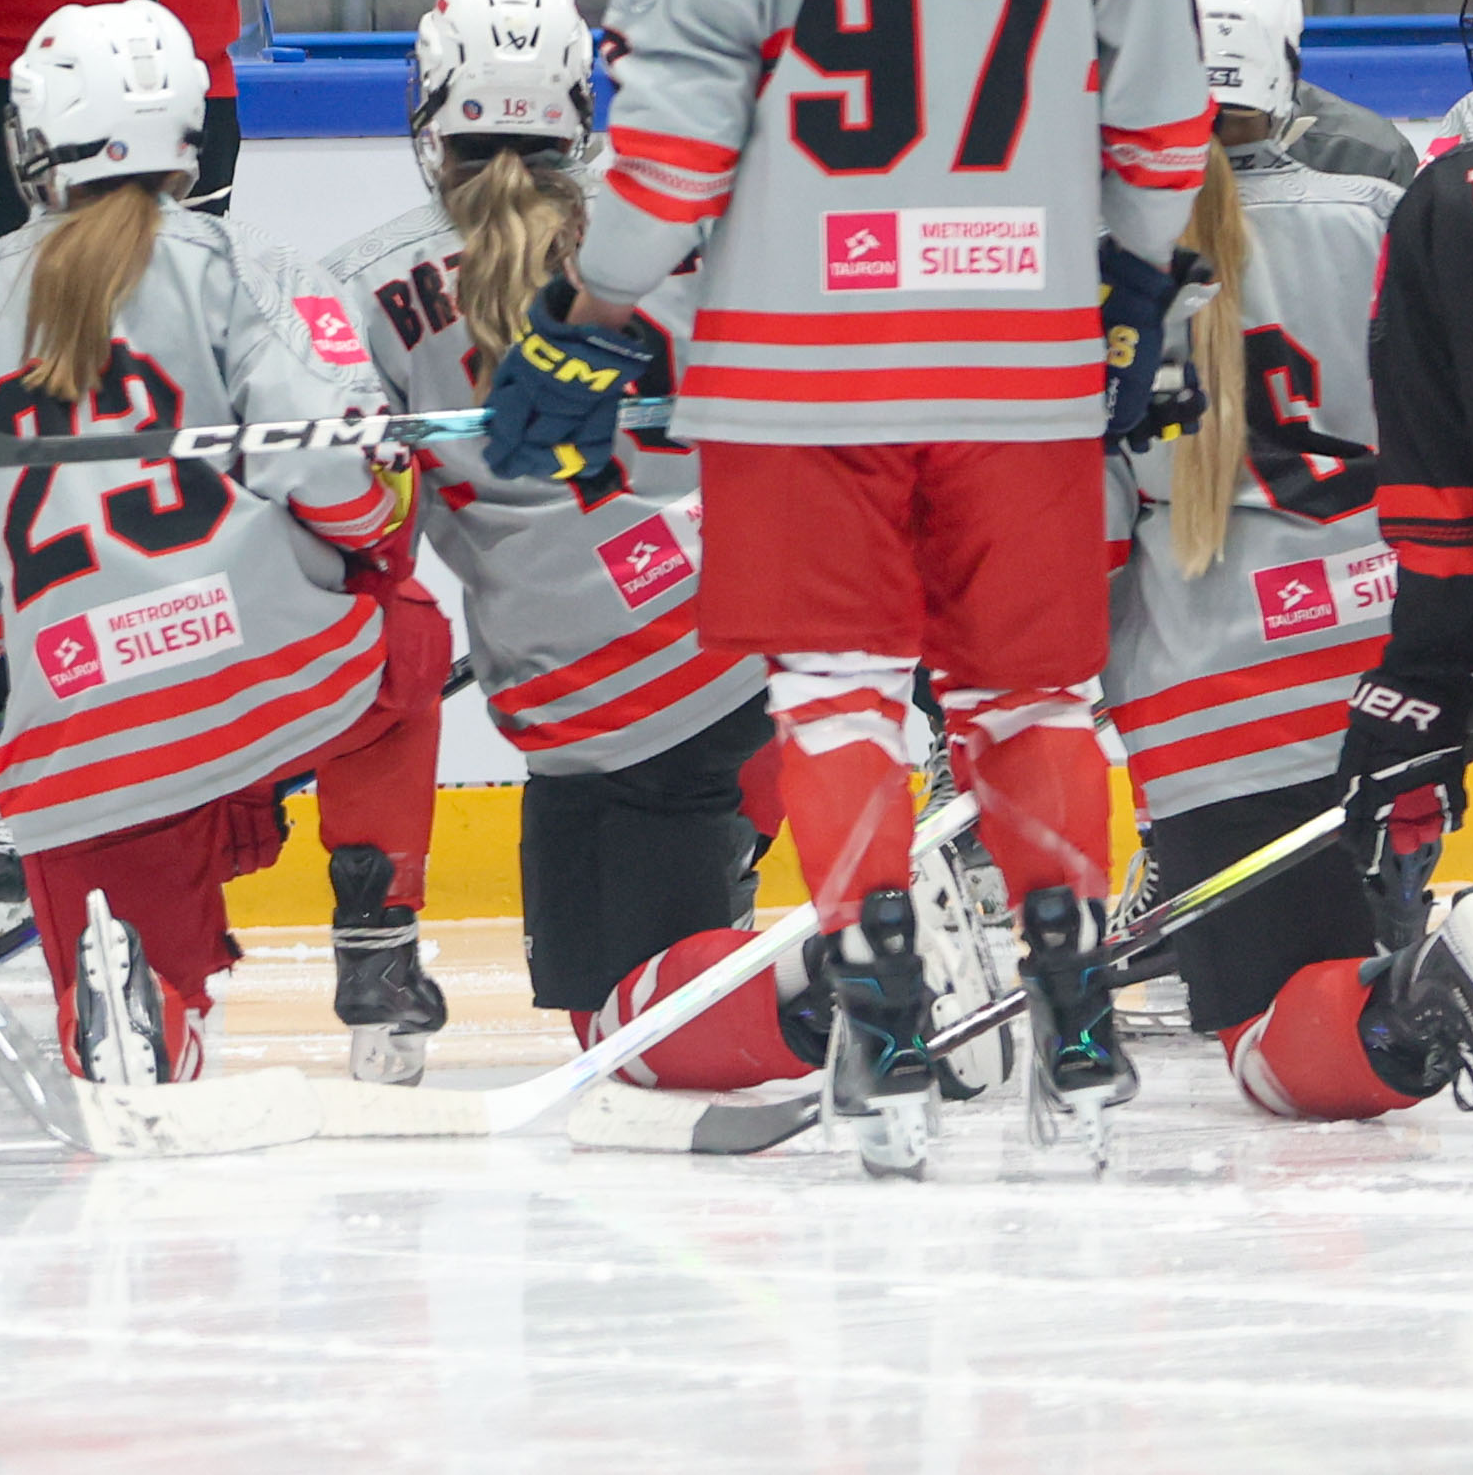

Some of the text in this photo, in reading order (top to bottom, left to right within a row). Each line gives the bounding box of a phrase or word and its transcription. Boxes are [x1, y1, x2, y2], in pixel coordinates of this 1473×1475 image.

[503, 98, 527, 118] 18
[829, 221, 1041, 278] TAURON METROPOLIA
[920, 246, 1041, 277] SILESIA
[170, 416, 390, 457] CCM
[622, 553, 685, 593] TAURON
[108, 586, 229, 634] METROPOLIA
[1264, 602, 1333, 629] TAURON
[117, 608, 236, 668] SILESIA
[50, 658, 102, 689] TAURON
